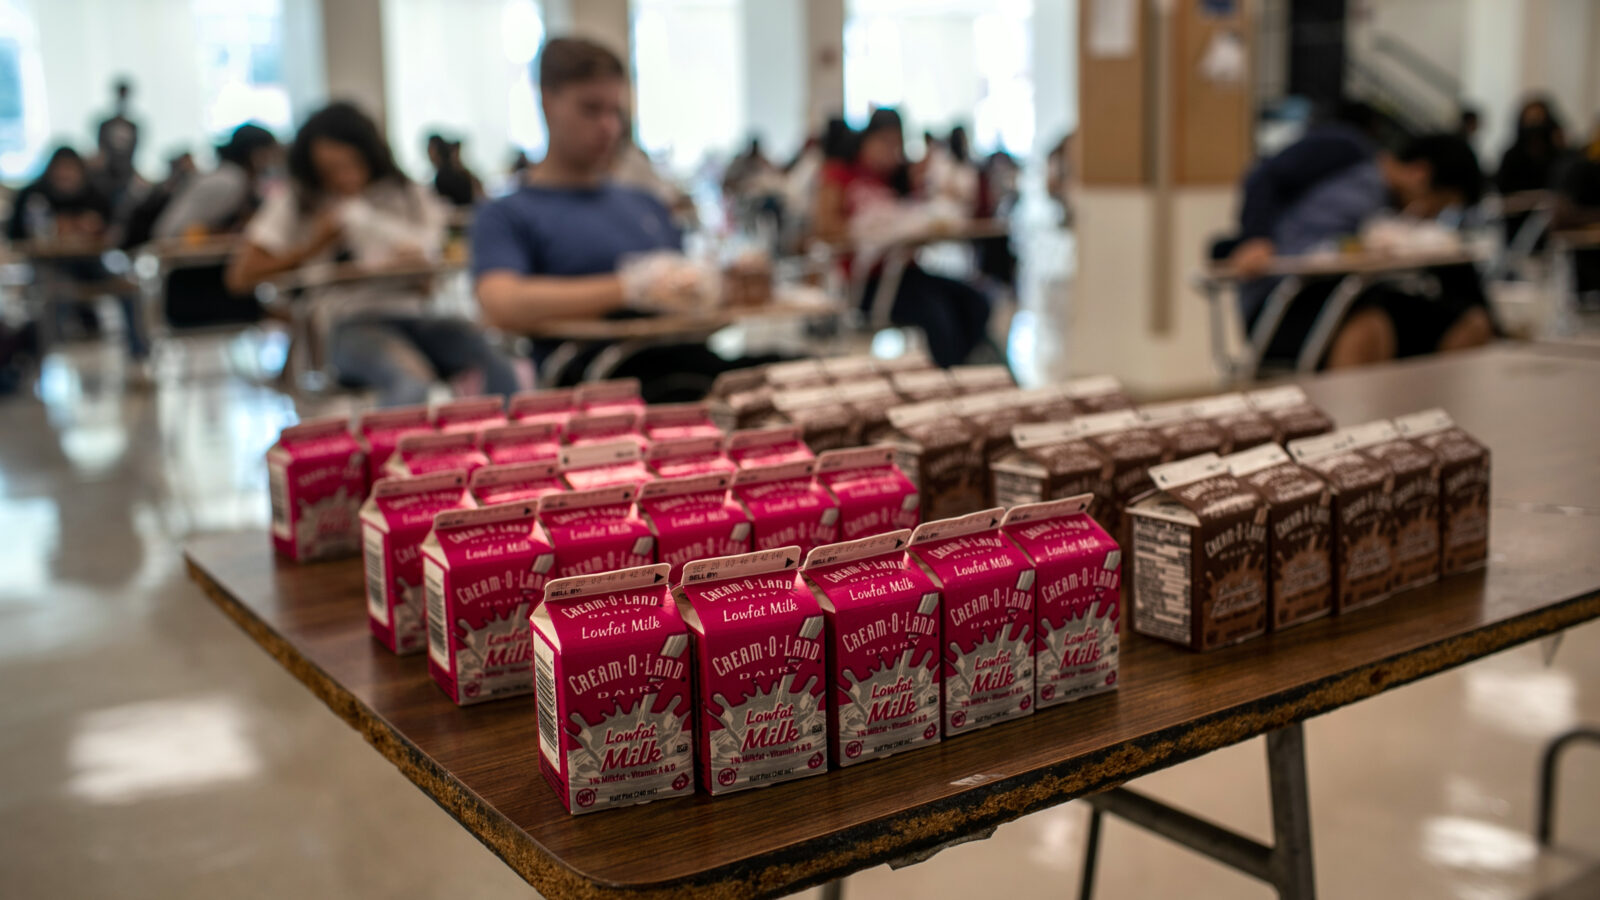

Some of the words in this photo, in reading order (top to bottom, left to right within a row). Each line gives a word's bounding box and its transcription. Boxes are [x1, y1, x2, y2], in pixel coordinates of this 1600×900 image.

[954, 561, 990, 577] Lowfat
[992, 554, 1014, 570] Milk
[849, 584, 887, 601] Lowfat
[890, 577, 915, 593] Milk
[723, 604, 767, 622] Lowfat
[769, 597, 799, 615] Milk
[581, 621, 627, 640] Lowfat
[631, 616, 662, 635] Milk
[1063, 625, 1099, 646] Lowfat
[974, 649, 1012, 671] Lowfat
[1060, 641, 1101, 671] Milk
[739, 663, 803, 681] DAIRY
[970, 667, 1015, 696] Milk
[597, 682, 665, 700] DAIRY
[872, 676, 913, 699] Lowfat
[746, 703, 794, 727] Lowfat
[866, 692, 918, 726] Milk
[605, 720, 657, 745] Lowfat
[741, 720, 800, 752] Milk
[601, 741, 663, 772] Milk
[631, 768, 657, 779] Vitamin
